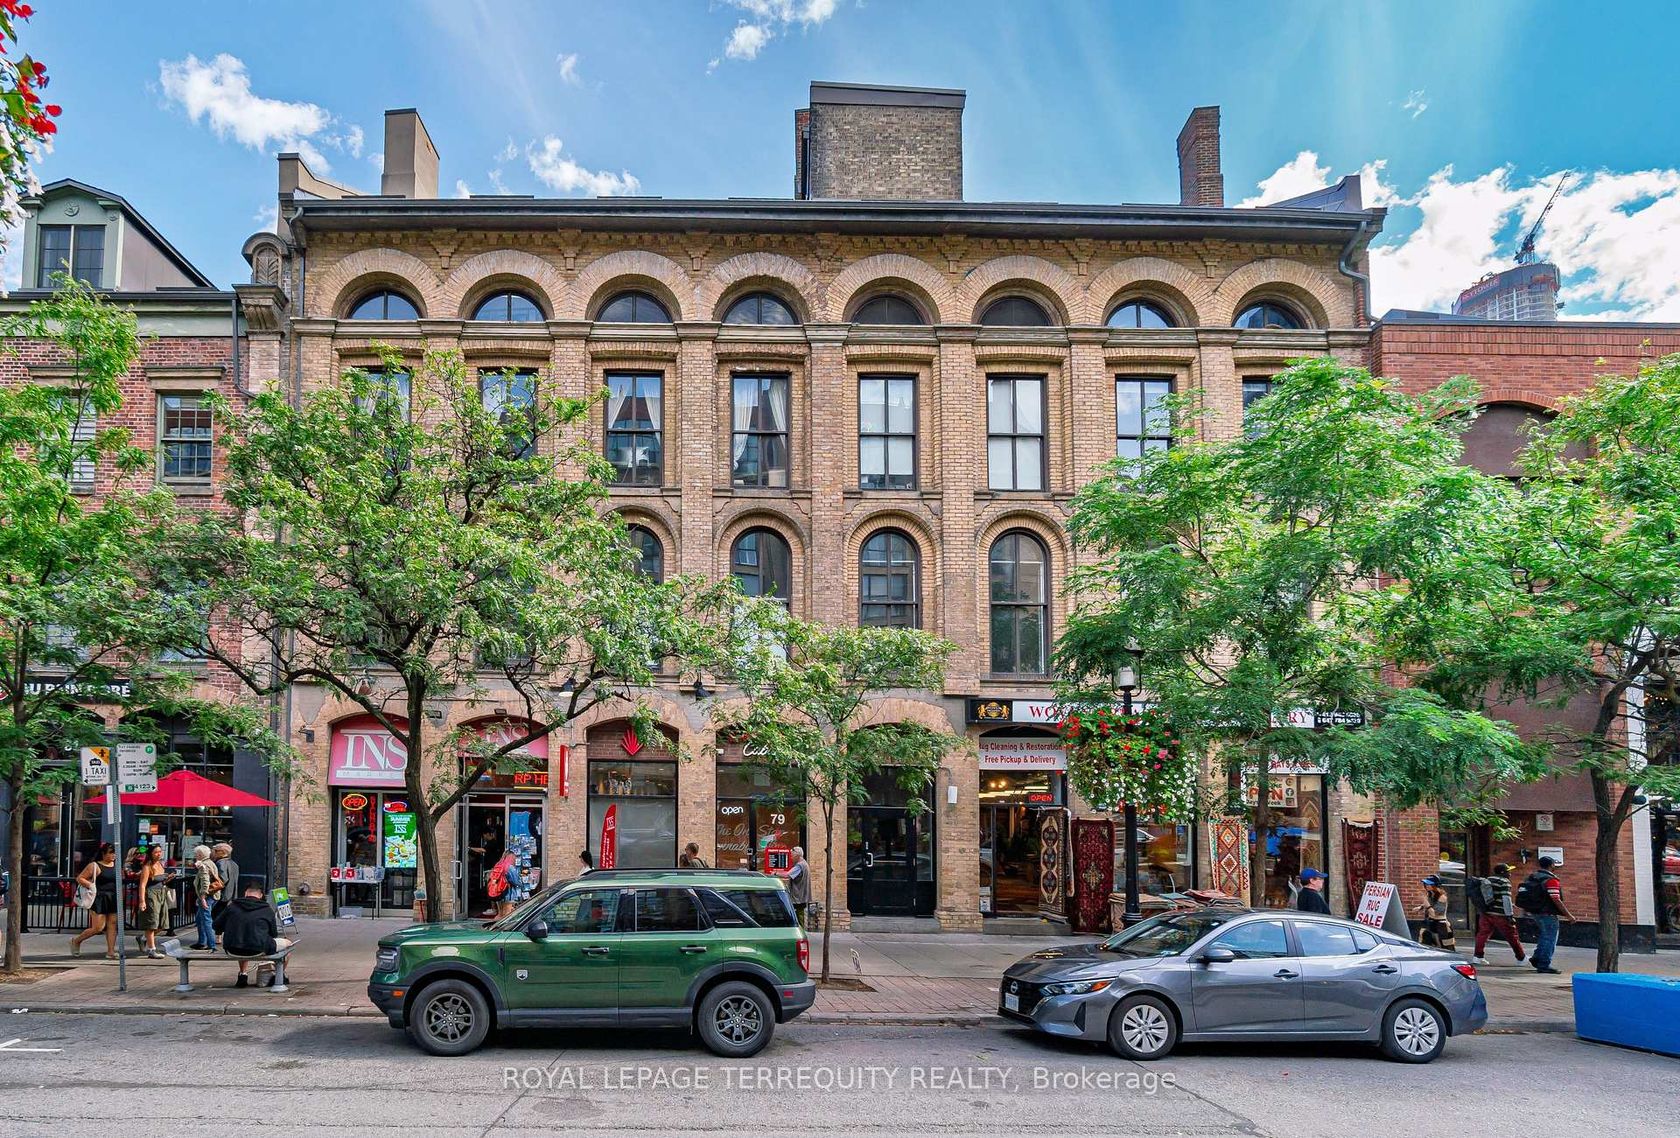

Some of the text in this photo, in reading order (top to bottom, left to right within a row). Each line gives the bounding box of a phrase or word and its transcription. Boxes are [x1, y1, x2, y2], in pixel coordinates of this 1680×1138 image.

[340, 734, 409, 771] INS
[991, 743, 1017, 752] Cleaning
[1000, 755, 1021, 764] Pickup
[1031, 755, 1056, 764] Delivery
[91, 767, 107, 775] TAXI
[1030, 794, 1053, 802] OPEN
[721, 806, 744, 815] open
[770, 813, 786, 825] 79
[1364, 884, 1392, 898] PERSIAN
[1366, 900, 1381, 911] RUG
[1358, 912, 1382, 927] SALE
